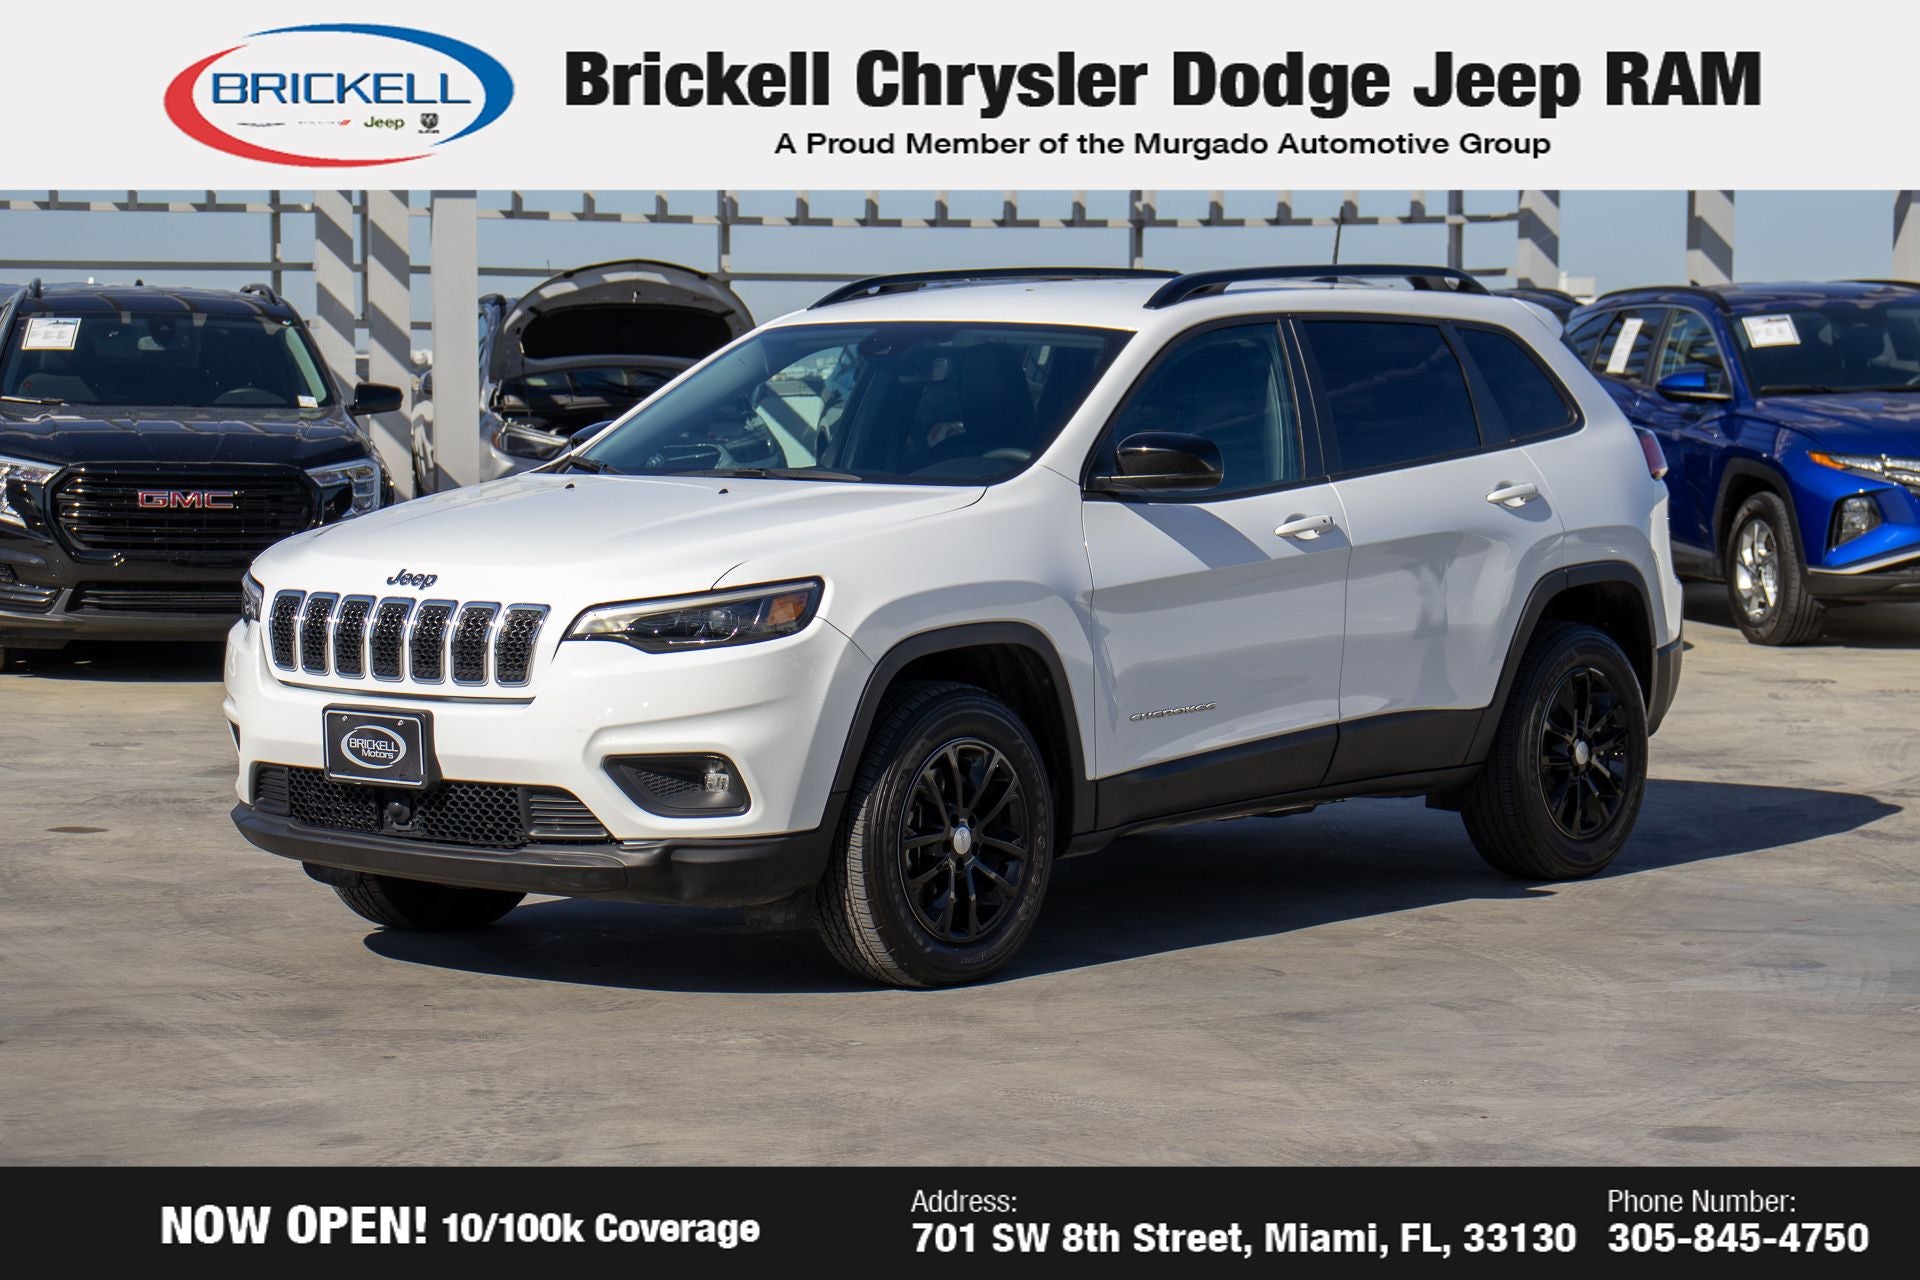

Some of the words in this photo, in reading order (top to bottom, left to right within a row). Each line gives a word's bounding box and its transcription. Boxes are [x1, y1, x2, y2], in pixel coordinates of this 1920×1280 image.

[138, 490, 234, 509] GMC
[386, 568, 438, 590] Jeep
[349, 737, 399, 753] BRICKELL
[361, 748, 394, 760] Motors
